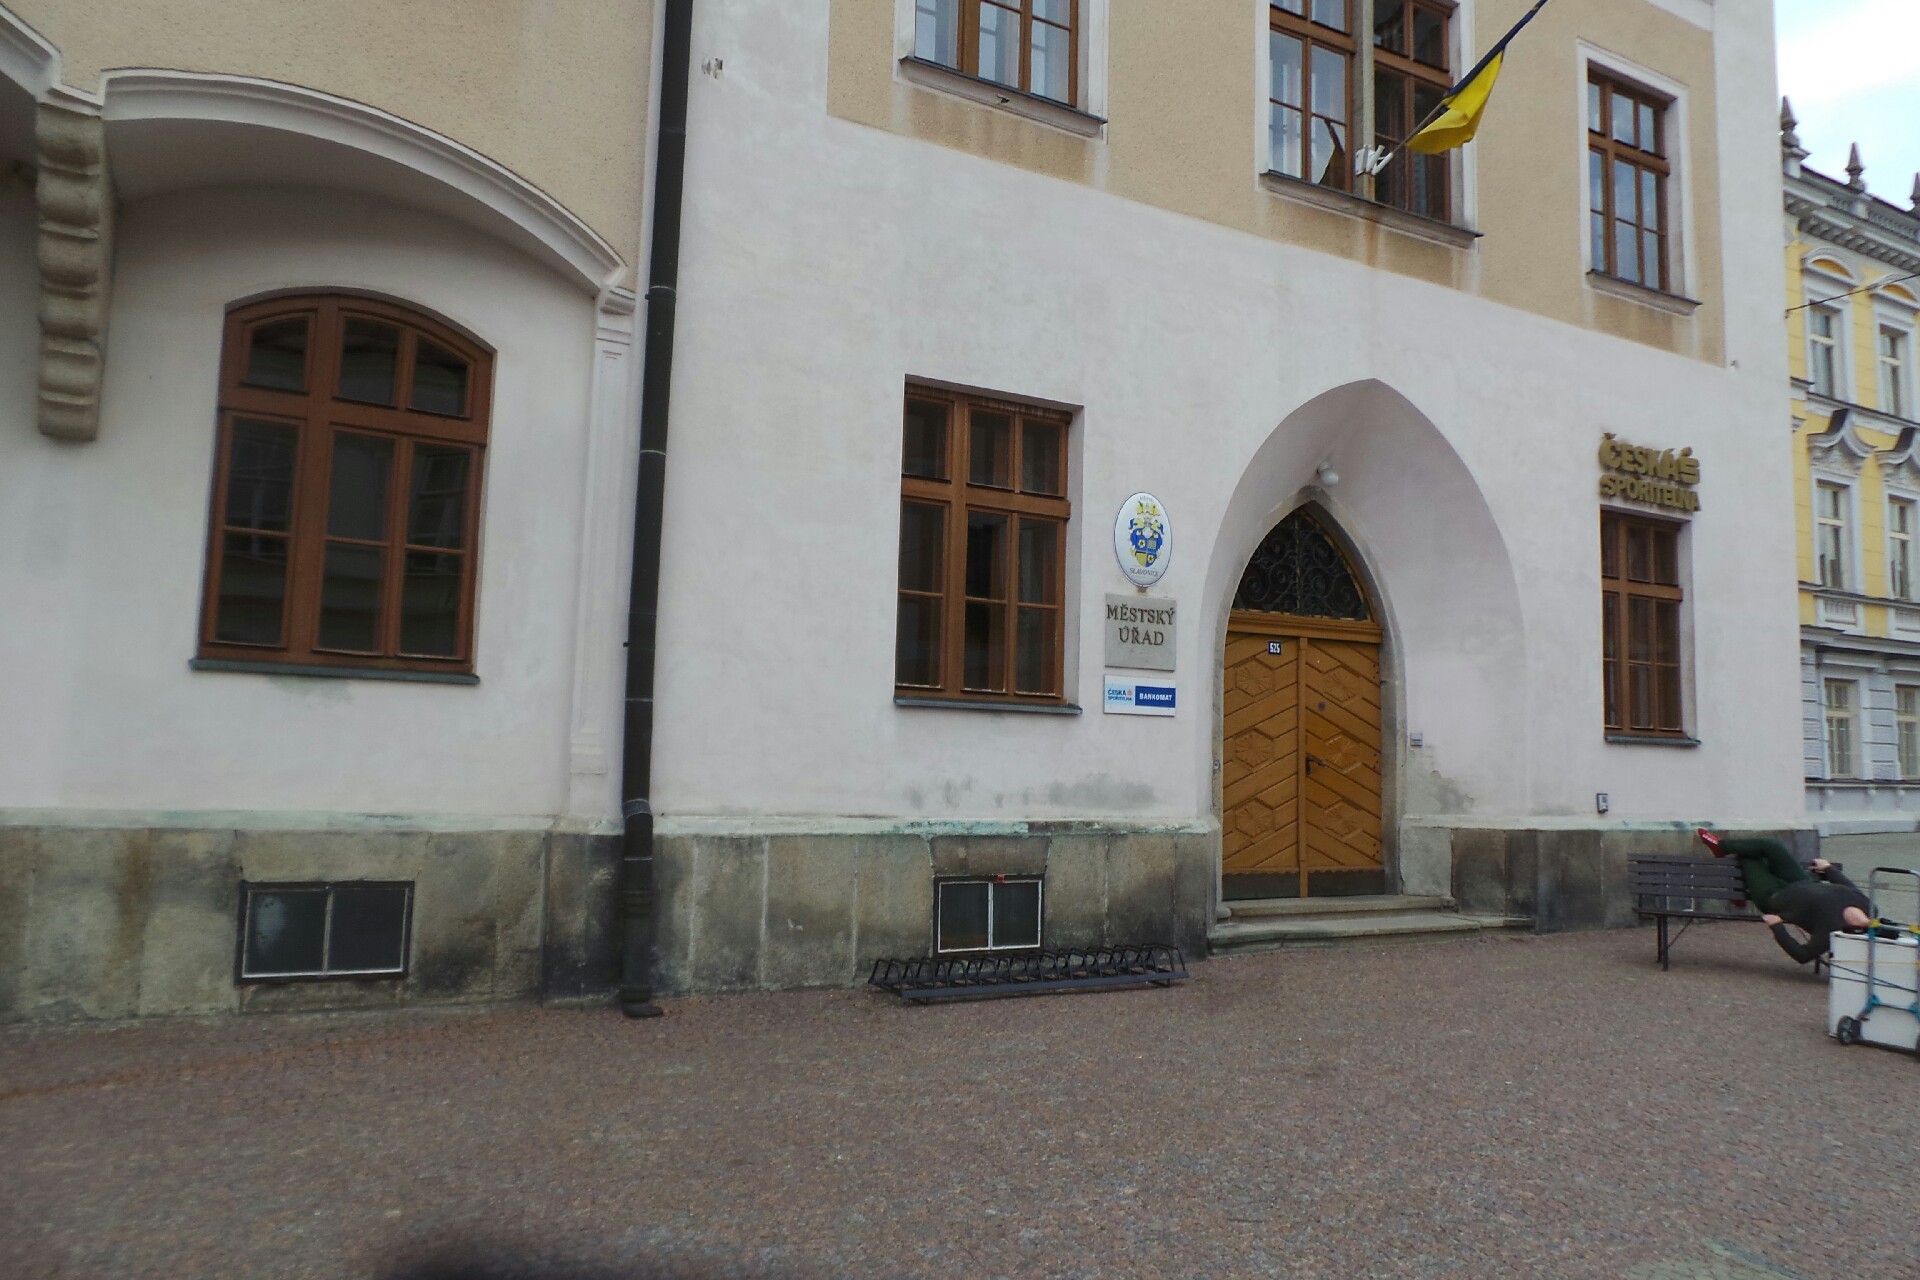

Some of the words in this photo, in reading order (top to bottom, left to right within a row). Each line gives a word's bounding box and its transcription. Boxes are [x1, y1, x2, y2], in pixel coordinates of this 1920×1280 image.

[1599, 432, 1678, 481] ČESKÁ
[1106, 603, 1175, 625] MĚSTSKÝ
[1118, 625, 1164, 646] ÚŘAD
[1269, 642, 1281, 654] 525
[1139, 693, 1173, 702] BANKOMAT
